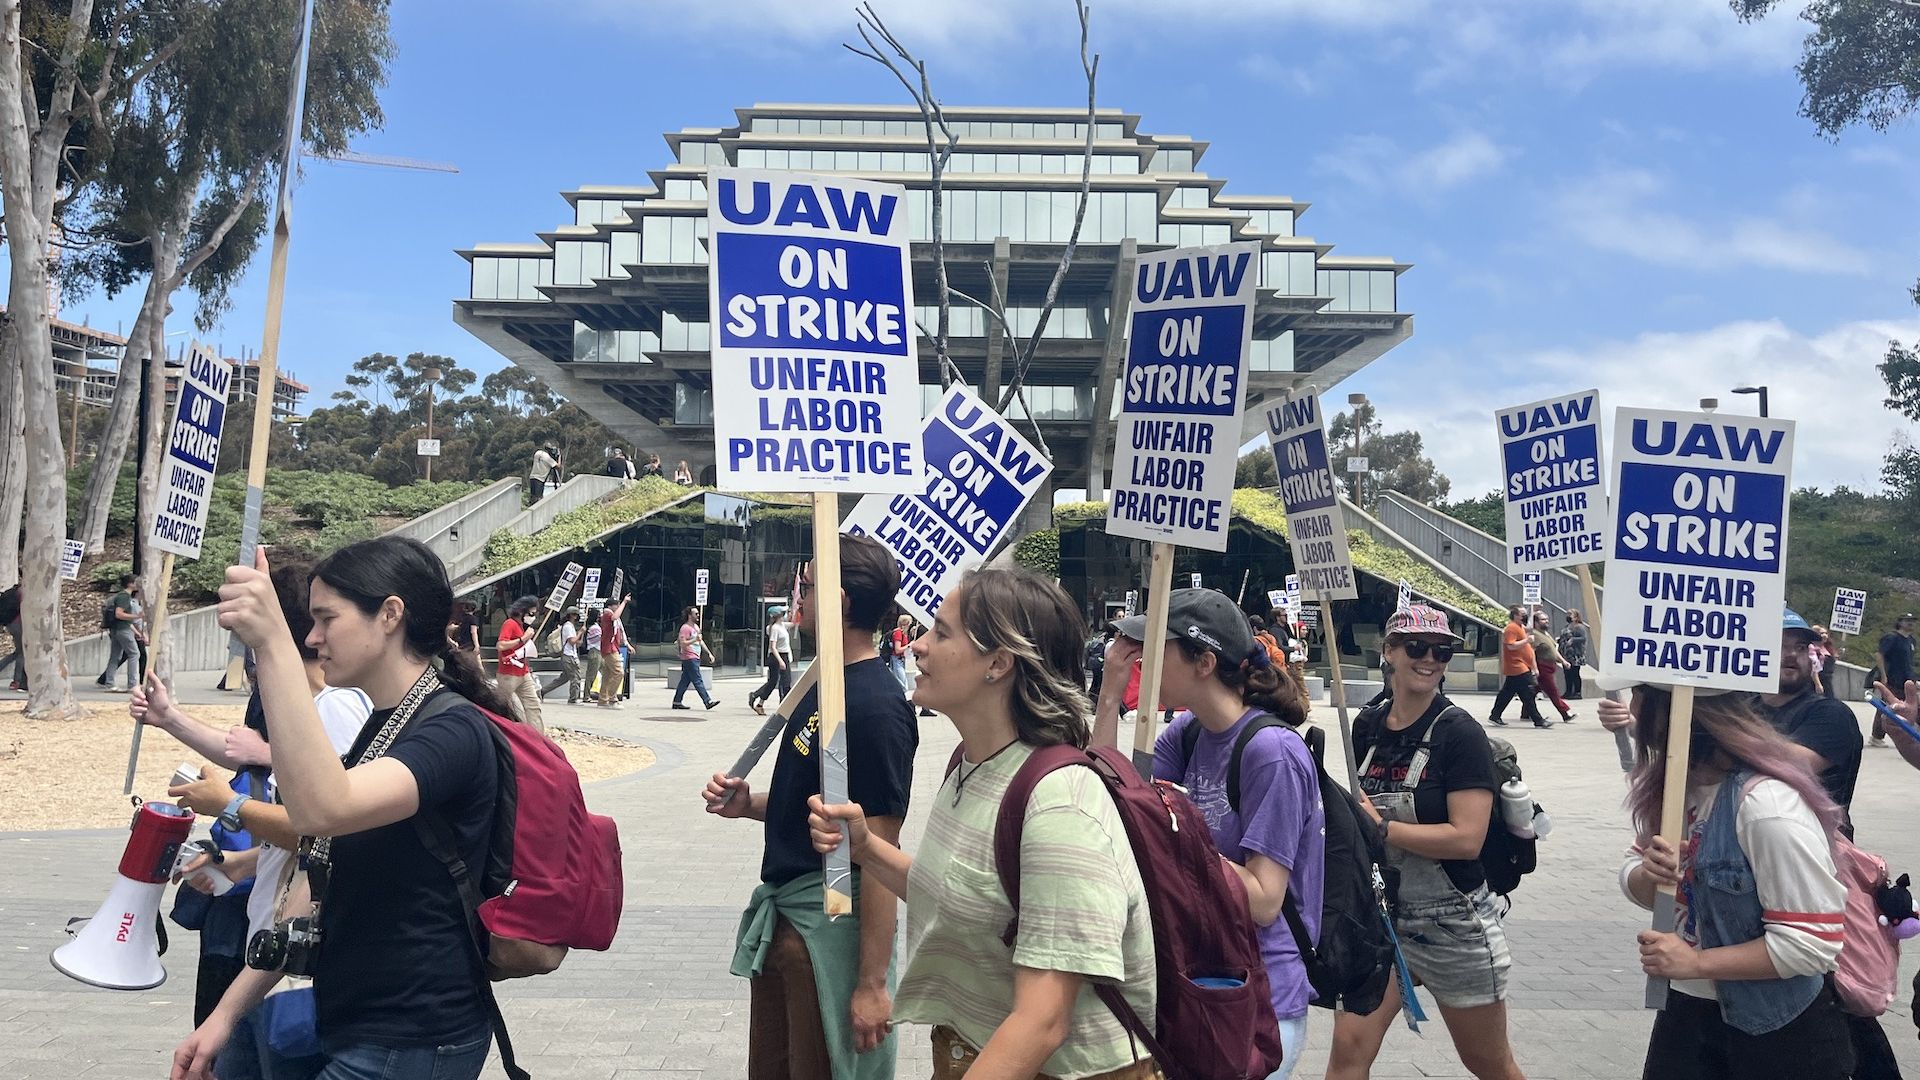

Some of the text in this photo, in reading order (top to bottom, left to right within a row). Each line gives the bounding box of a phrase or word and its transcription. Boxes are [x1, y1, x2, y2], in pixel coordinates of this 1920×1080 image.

[718, 178, 898, 237] UAW
[778, 244, 849, 290] ON
[1137, 252, 1251, 304] UAW
[725, 293, 902, 345] STRIKE
[1158, 315, 1203, 358] ON
[189, 349, 229, 395] UAW
[750, 357, 887, 395] UNFAIR
[1126, 362, 1235, 406] STRIKE
[190, 393, 212, 428] ON
[758, 397, 882, 434] LABOR
[1266, 395, 1315, 436] UAW
[1500, 395, 1594, 438] UAW
[173, 419, 218, 465] STRIKE
[729, 438, 913, 476] PRACTICE
[945, 391, 1046, 487] UAW
[1132, 420, 1214, 454] UNFAIR
[1287, 437, 1309, 471] ON
[1530, 434, 1566, 464] ON
[1631, 418, 1785, 465] UAW
[170, 464, 205, 497] UNFAIR
[948, 449, 995, 498] ON
[1131, 455, 1205, 492] LABOR
[1282, 467, 1333, 507] STRIKE
[1509, 457, 1596, 497] STRIKE
[1672, 471, 1736, 514] ON
[166, 490, 200, 522] LABOR
[924, 461, 999, 548] TRIKE
[1113, 489, 1222, 532] PRACTICE
[1520, 491, 1588, 520] UNFAIR
[154, 514, 202, 548] PRACTICE
[889, 494, 966, 567] UNFAIR
[1293, 514, 1333, 541] UNFAIR
[1525, 513, 1585, 541] LABOR
[1622, 510, 1777, 561] STRIKE
[874, 515, 947, 585] LABOR
[1301, 540, 1336, 565] LABOR
[1513, 532, 1603, 564] PRACTICE
[1298, 565, 1351, 591] PRACTICE
[1639, 570, 1756, 608] UNFAIR
[1838, 590, 1864, 599] UAW
[1642, 604, 1747, 642] LABOR
[1614, 635, 1770, 678] PRACTICE
[116, 912, 135, 942] PYLE
